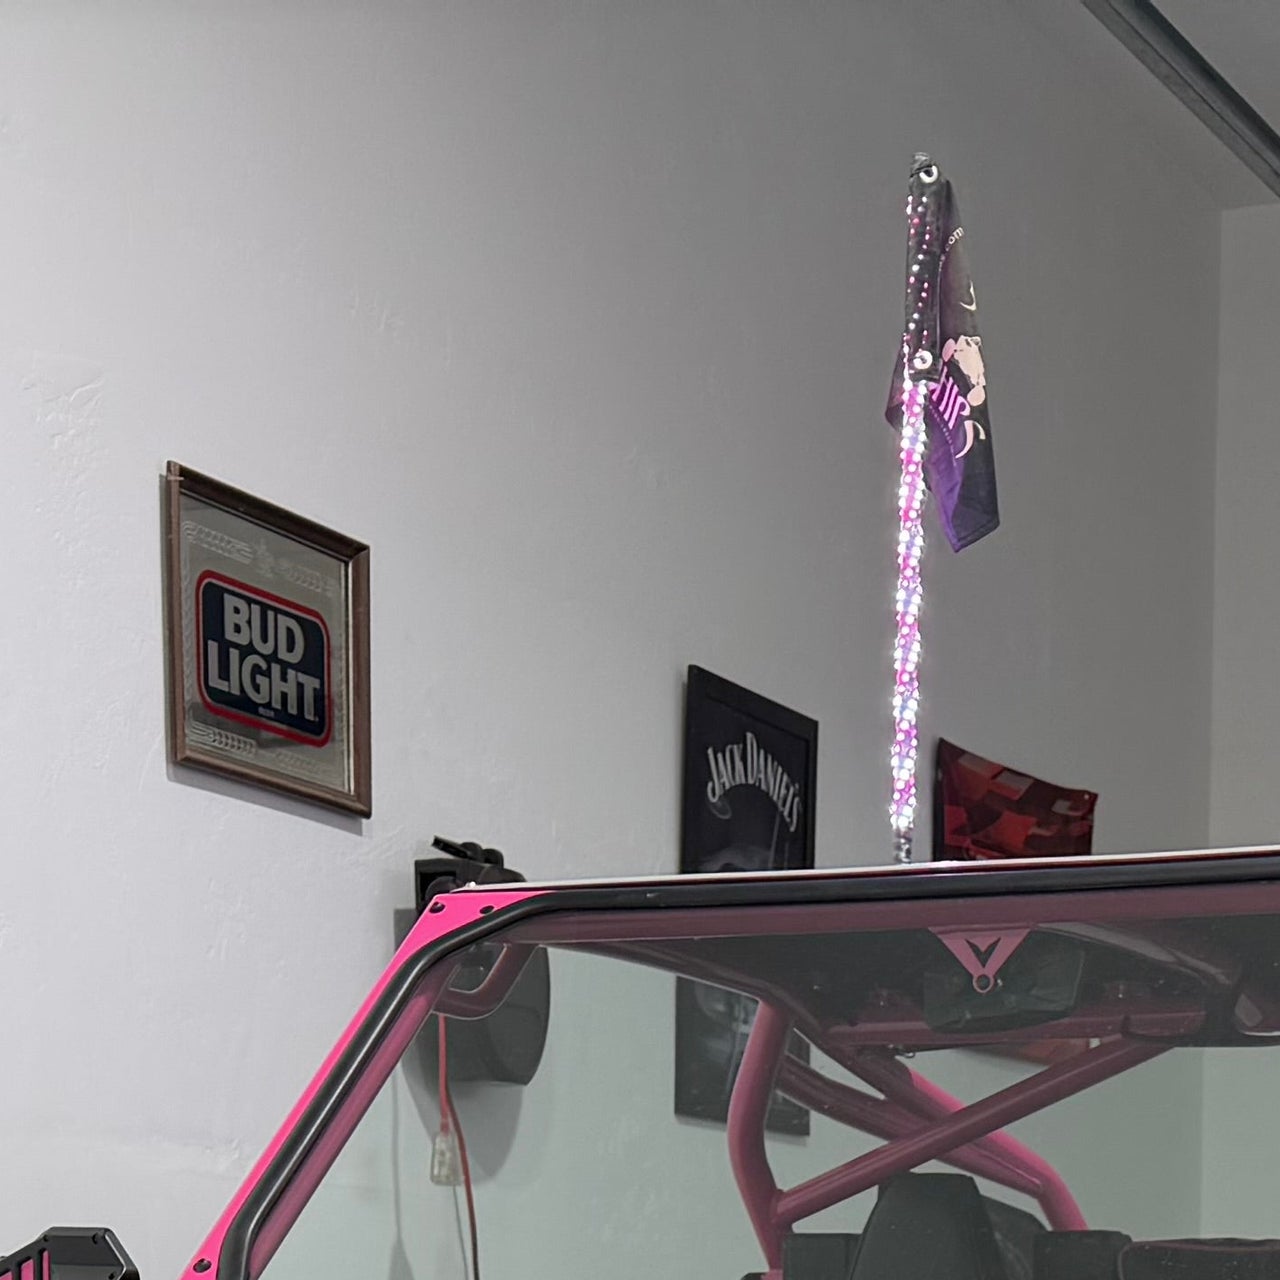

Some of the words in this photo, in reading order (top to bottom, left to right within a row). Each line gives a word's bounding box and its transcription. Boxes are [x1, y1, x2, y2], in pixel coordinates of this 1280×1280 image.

[223, 592, 305, 664] BUD
[207, 639, 320, 722] LIGHT
[707, 743, 747, 803] JACK
